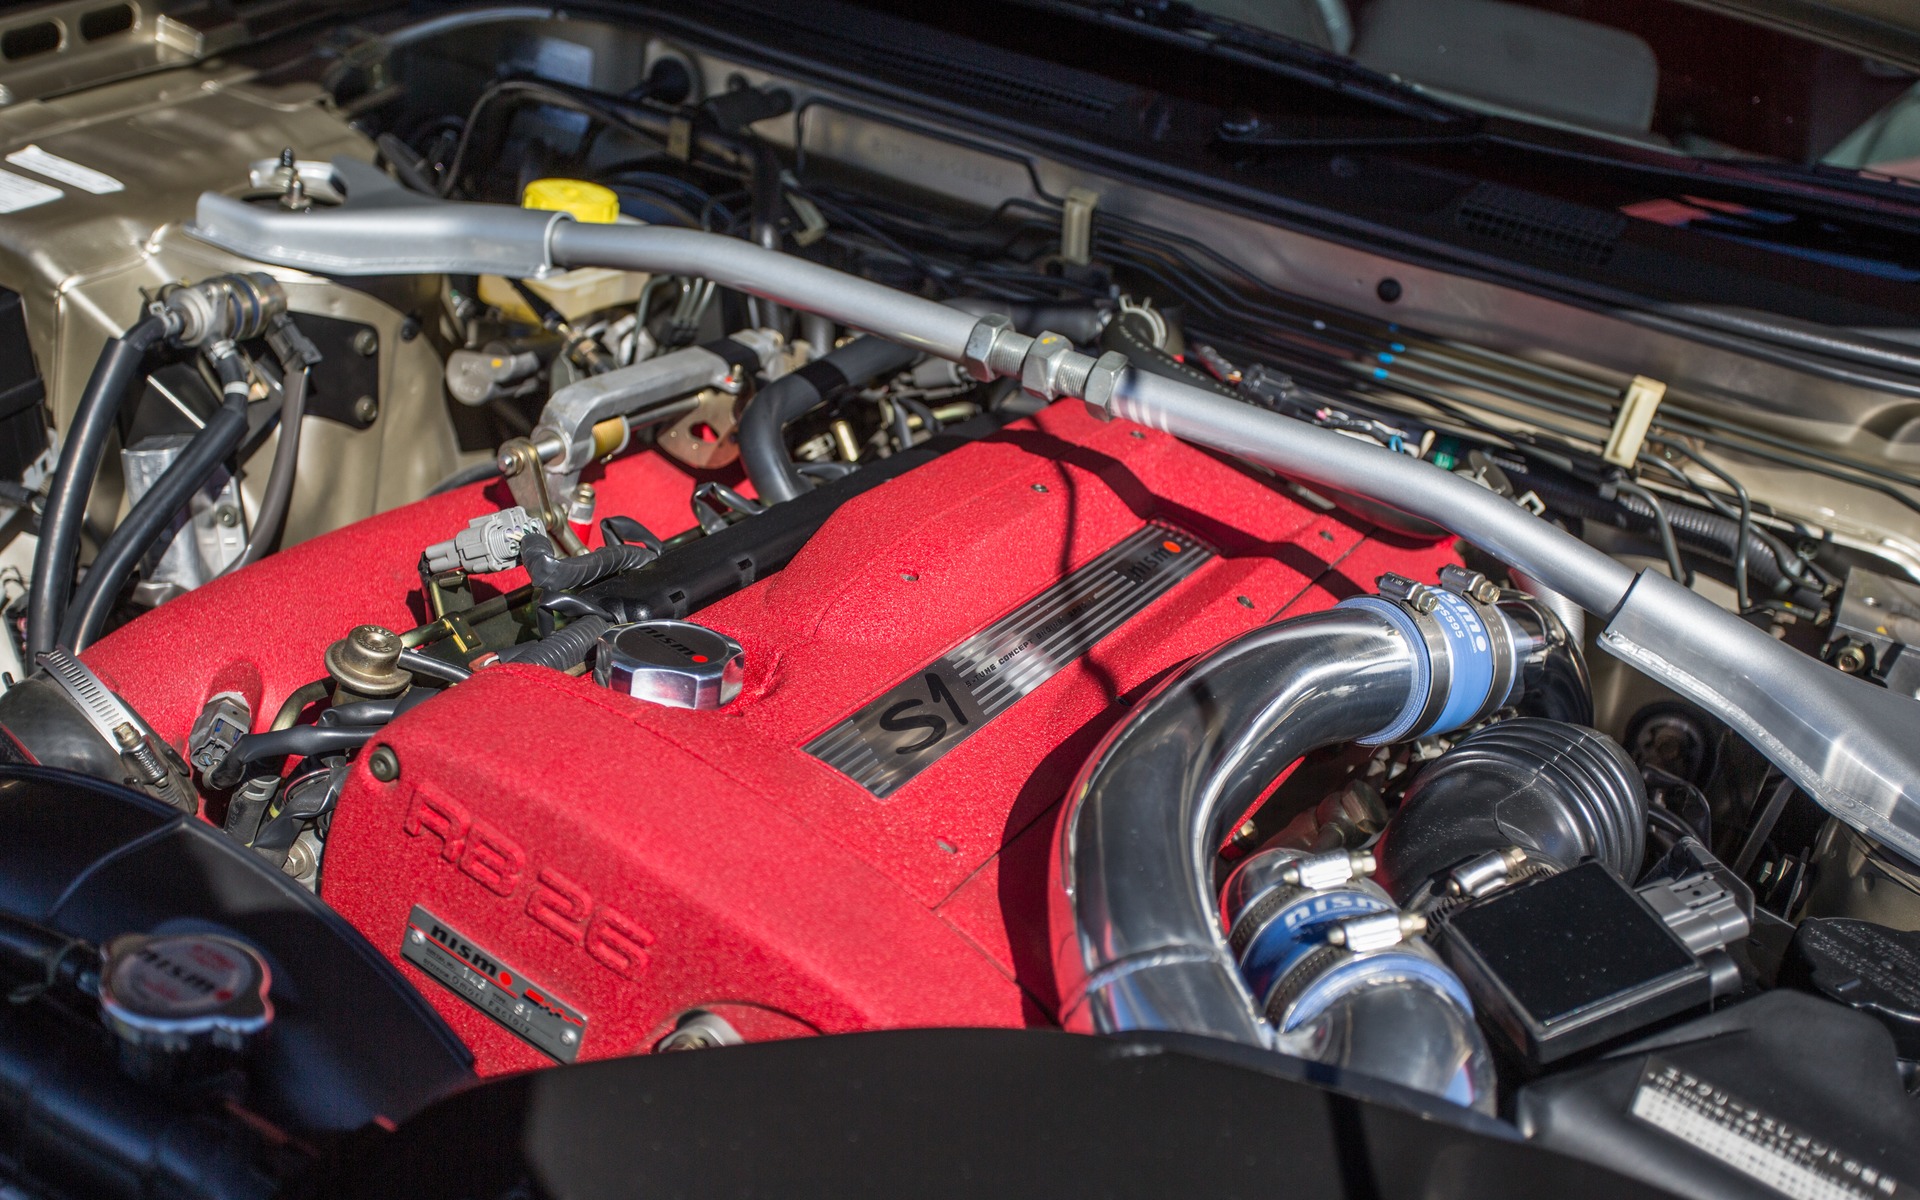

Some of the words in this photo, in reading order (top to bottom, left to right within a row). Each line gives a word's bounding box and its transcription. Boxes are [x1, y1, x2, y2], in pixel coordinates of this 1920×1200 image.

[998, 639, 1034, 665] CONCEPT
[879, 672, 969, 755] S1
[1284, 896, 1390, 928] nism
[430, 925, 513, 987] nismo
[488, 1000, 531, 1034] Factory
